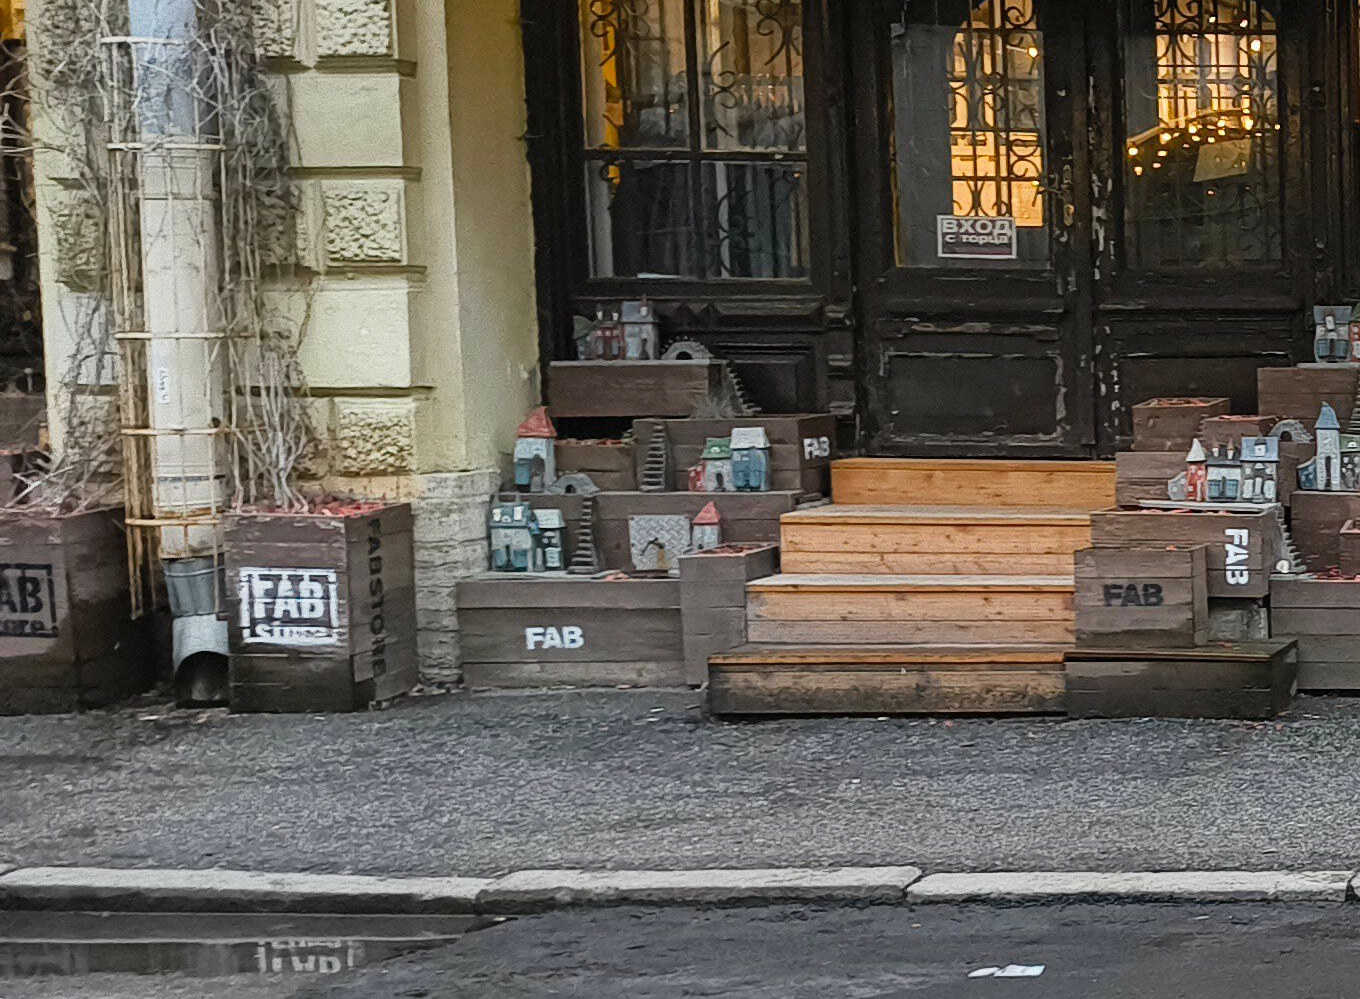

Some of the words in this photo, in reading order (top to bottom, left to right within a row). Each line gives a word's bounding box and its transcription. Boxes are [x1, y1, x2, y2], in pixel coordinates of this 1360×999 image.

[942, 219, 1012, 237] ВХОД
[1224, 528, 1250, 585] FAB
[0, 576, 43, 613] AB
[1103, 583, 1165, 607] FAB
[524, 626, 585, 650] FAB
